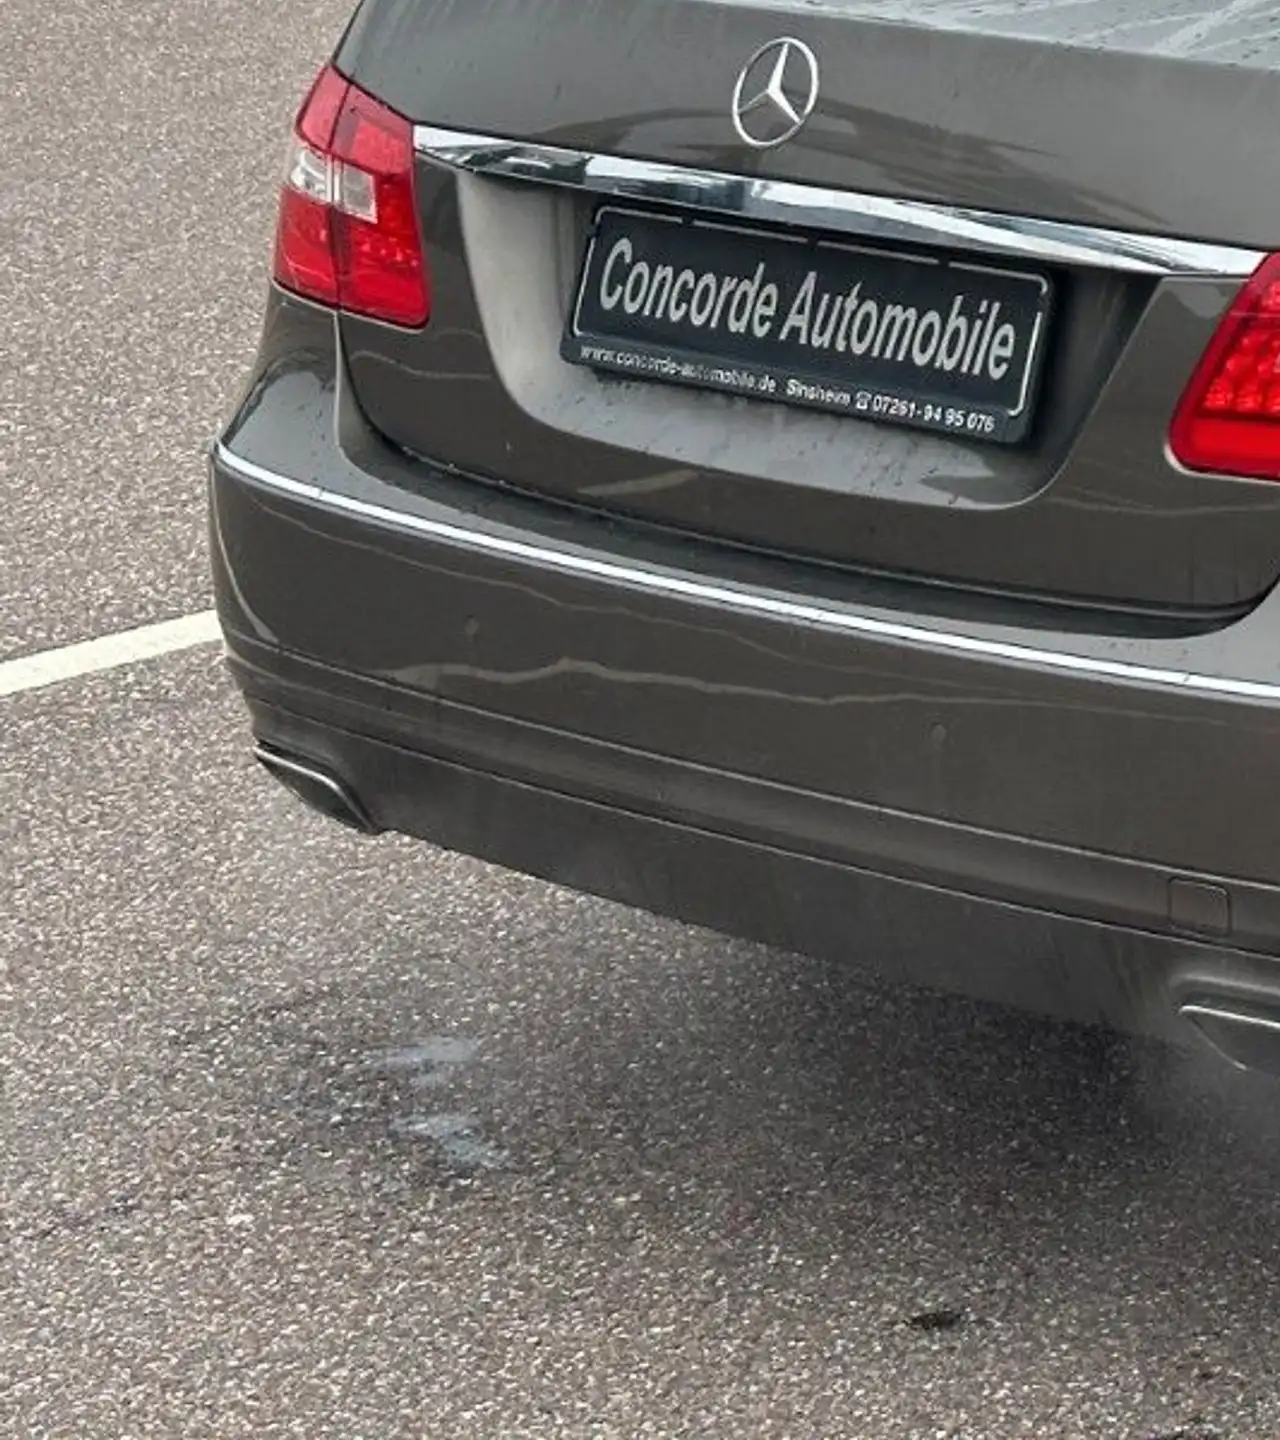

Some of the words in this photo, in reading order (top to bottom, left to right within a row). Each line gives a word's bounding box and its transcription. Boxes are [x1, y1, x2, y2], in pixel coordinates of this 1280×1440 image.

[600, 237, 779, 338] Concorde
[779, 271, 1016, 381] Automobile
[785, 378, 851, 407] Sinsheim
